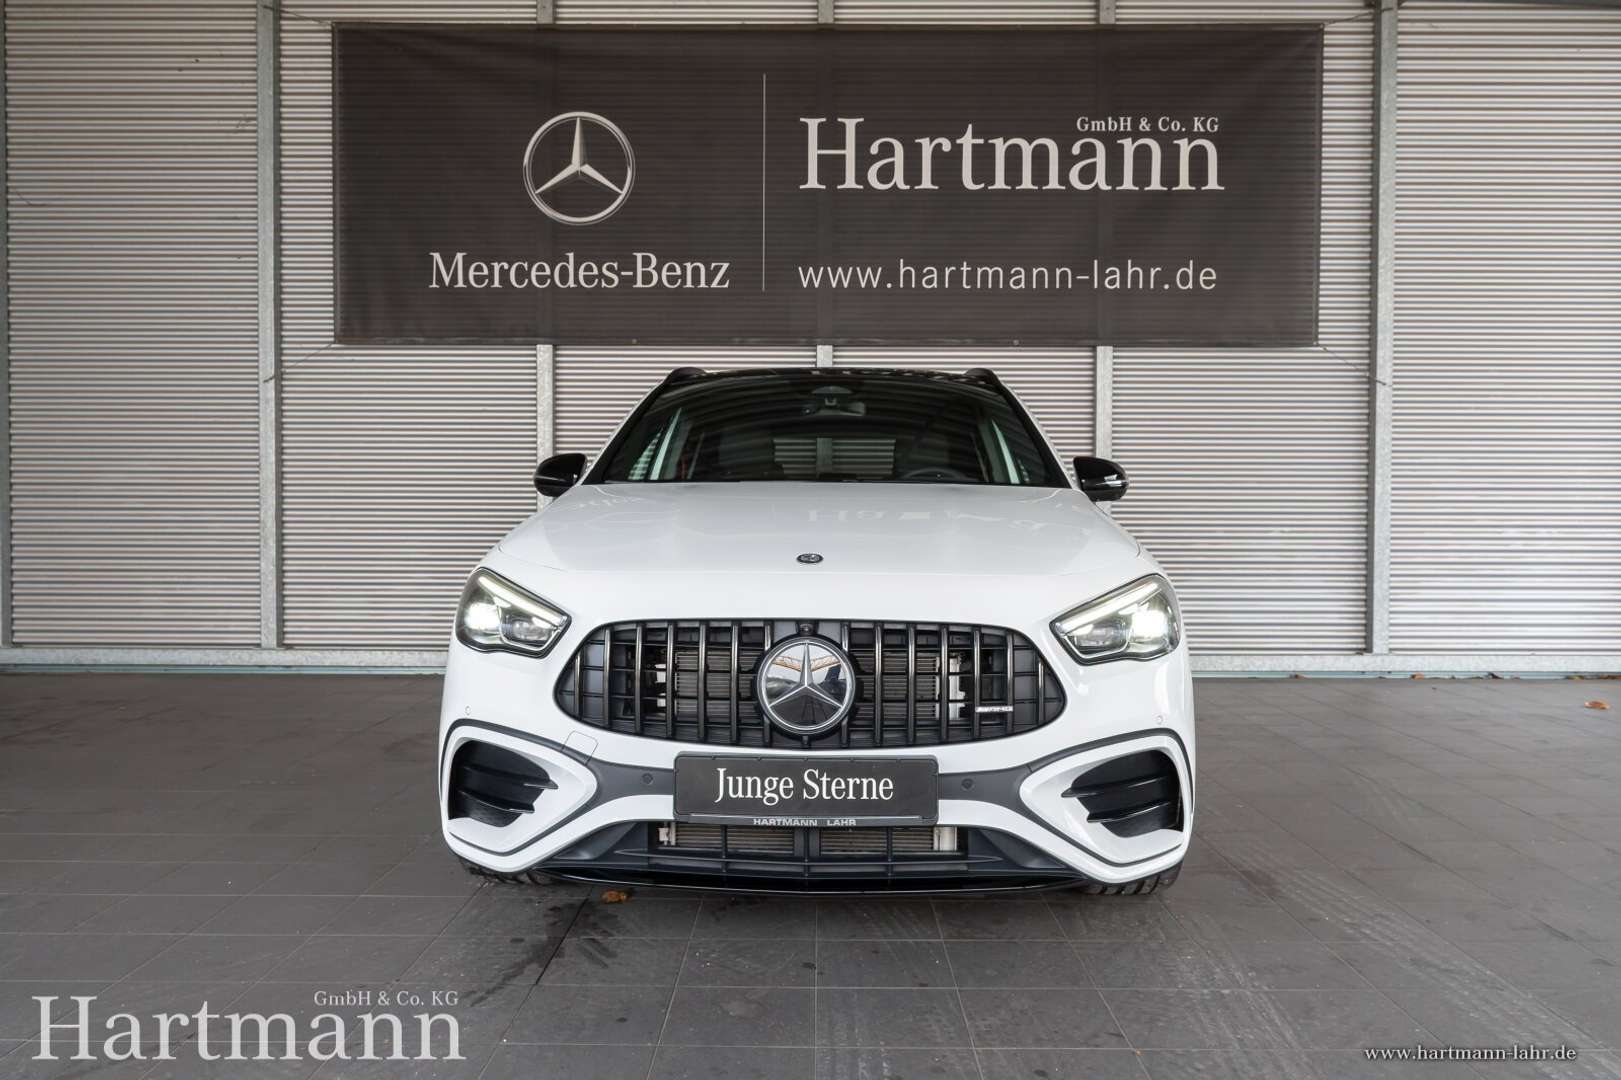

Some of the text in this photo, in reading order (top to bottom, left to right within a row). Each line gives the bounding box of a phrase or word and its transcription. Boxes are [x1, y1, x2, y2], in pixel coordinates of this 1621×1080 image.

[1076, 117, 1219, 133] GmbH & Co. KG
[800, 117, 1225, 191] Hartmann
[429, 252, 730, 289] Mercedes-Benz
[798, 258, 1217, 290] www.hartmann-lahr.de
[715, 767, 894, 806] Junge Sterne
[753, 818, 856, 827] HARTMANN LAHR
